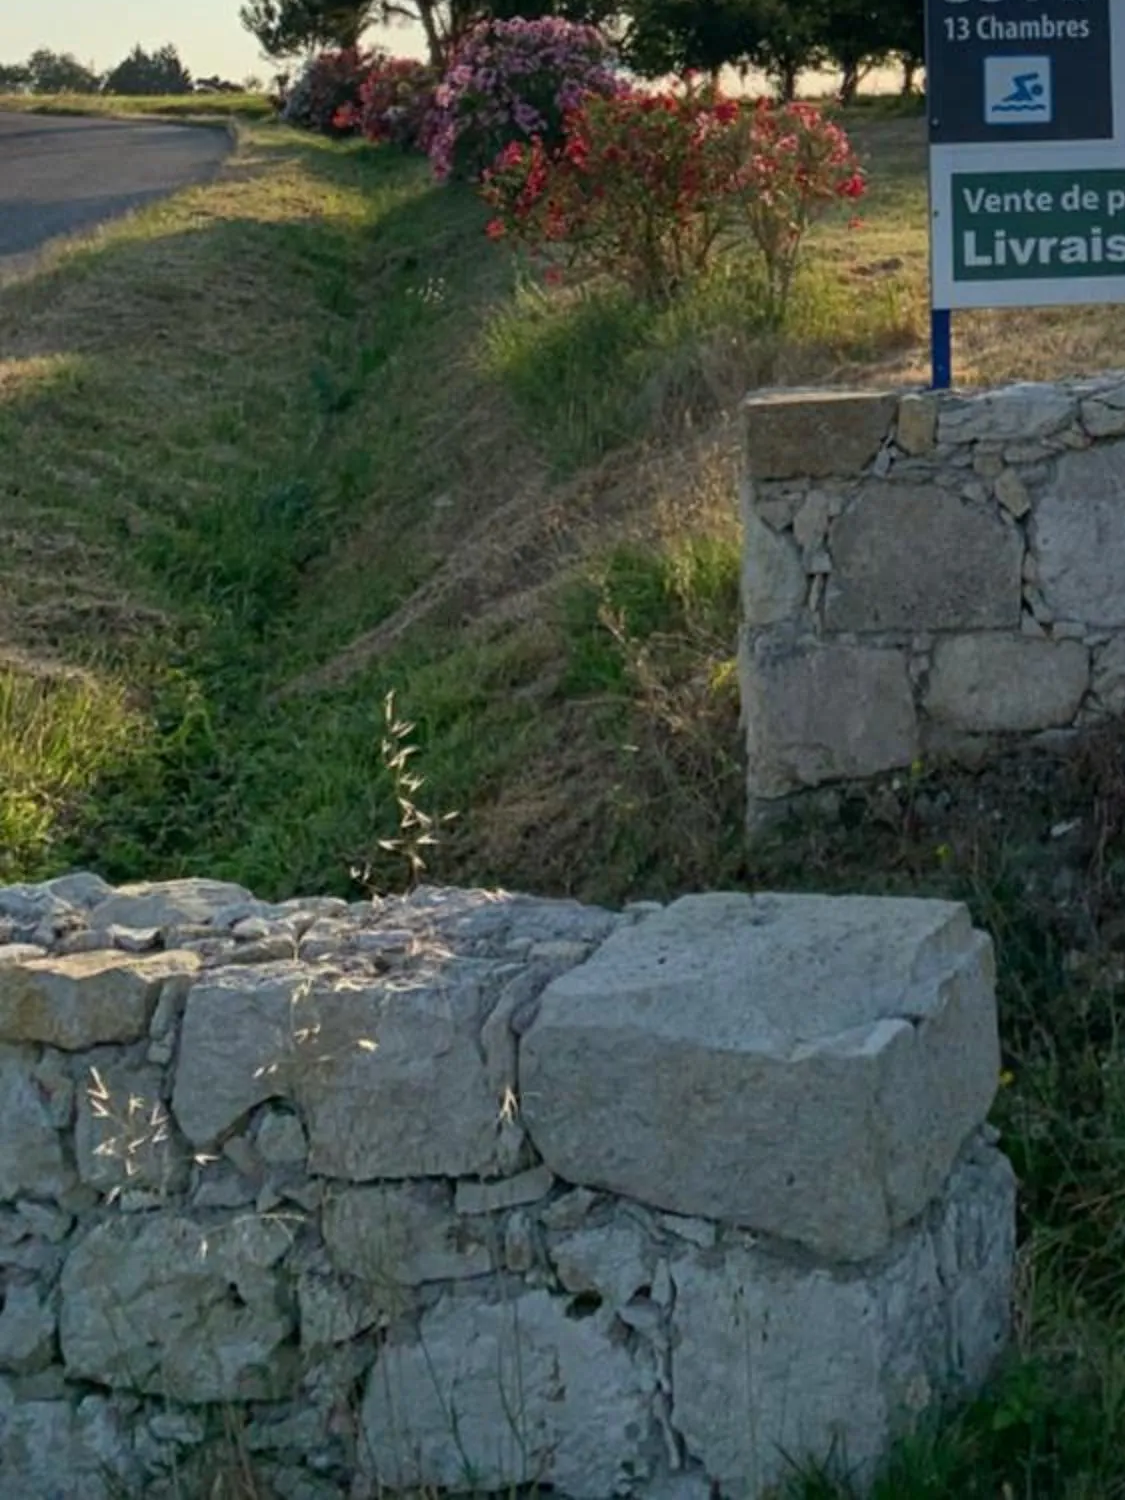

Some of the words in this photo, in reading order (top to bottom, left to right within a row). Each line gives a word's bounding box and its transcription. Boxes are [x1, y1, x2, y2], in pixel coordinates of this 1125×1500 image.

[944, 16, 970, 41] 13
[976, 13, 1090, 40] Chambres
[962, 187, 1053, 214] Vente
[1060, 184, 1099, 211] de
